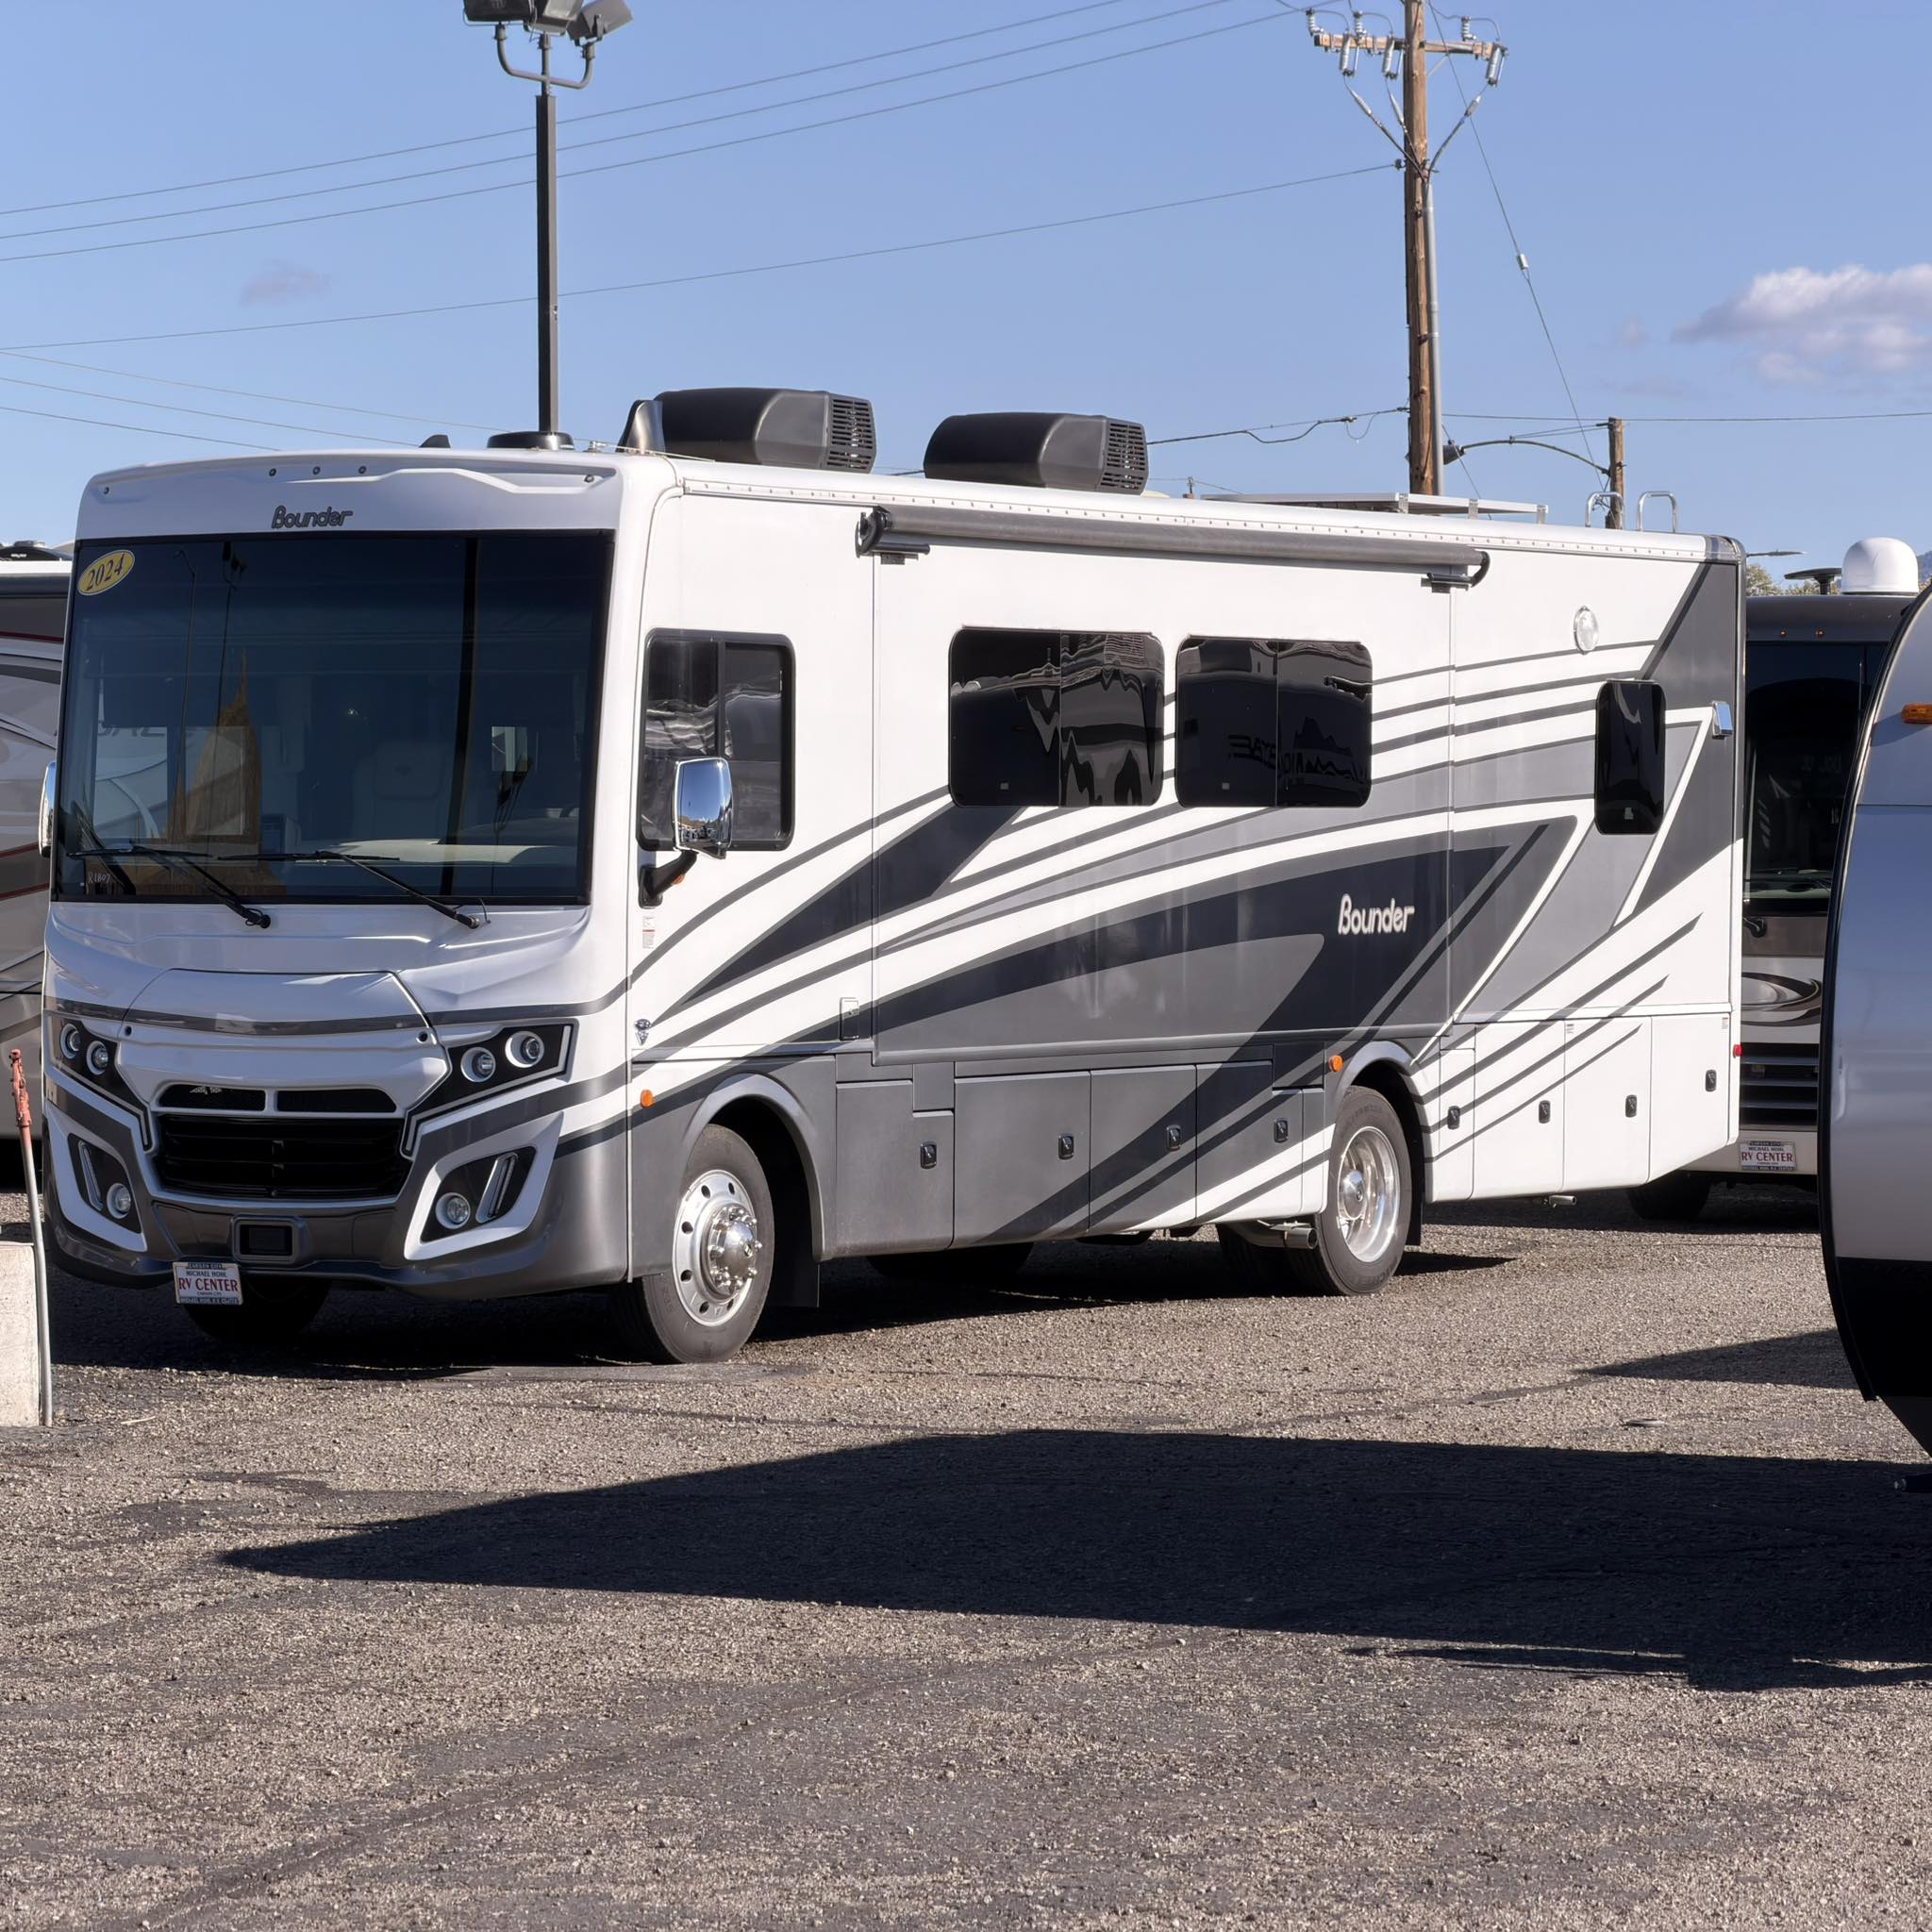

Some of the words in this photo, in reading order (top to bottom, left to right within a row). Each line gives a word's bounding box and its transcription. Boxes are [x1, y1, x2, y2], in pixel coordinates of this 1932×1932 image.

[271, 505, 354, 529] Bounder
[86, 554, 125, 591] 2024
[1337, 893, 1415, 936] Bounder
[1741, 1152, 1753, 1160] RV
[1756, 1152, 1793, 1162] CENTER
[178, 1277, 192, 1291] RV
[195, 1277, 239, 1291] CENTER
